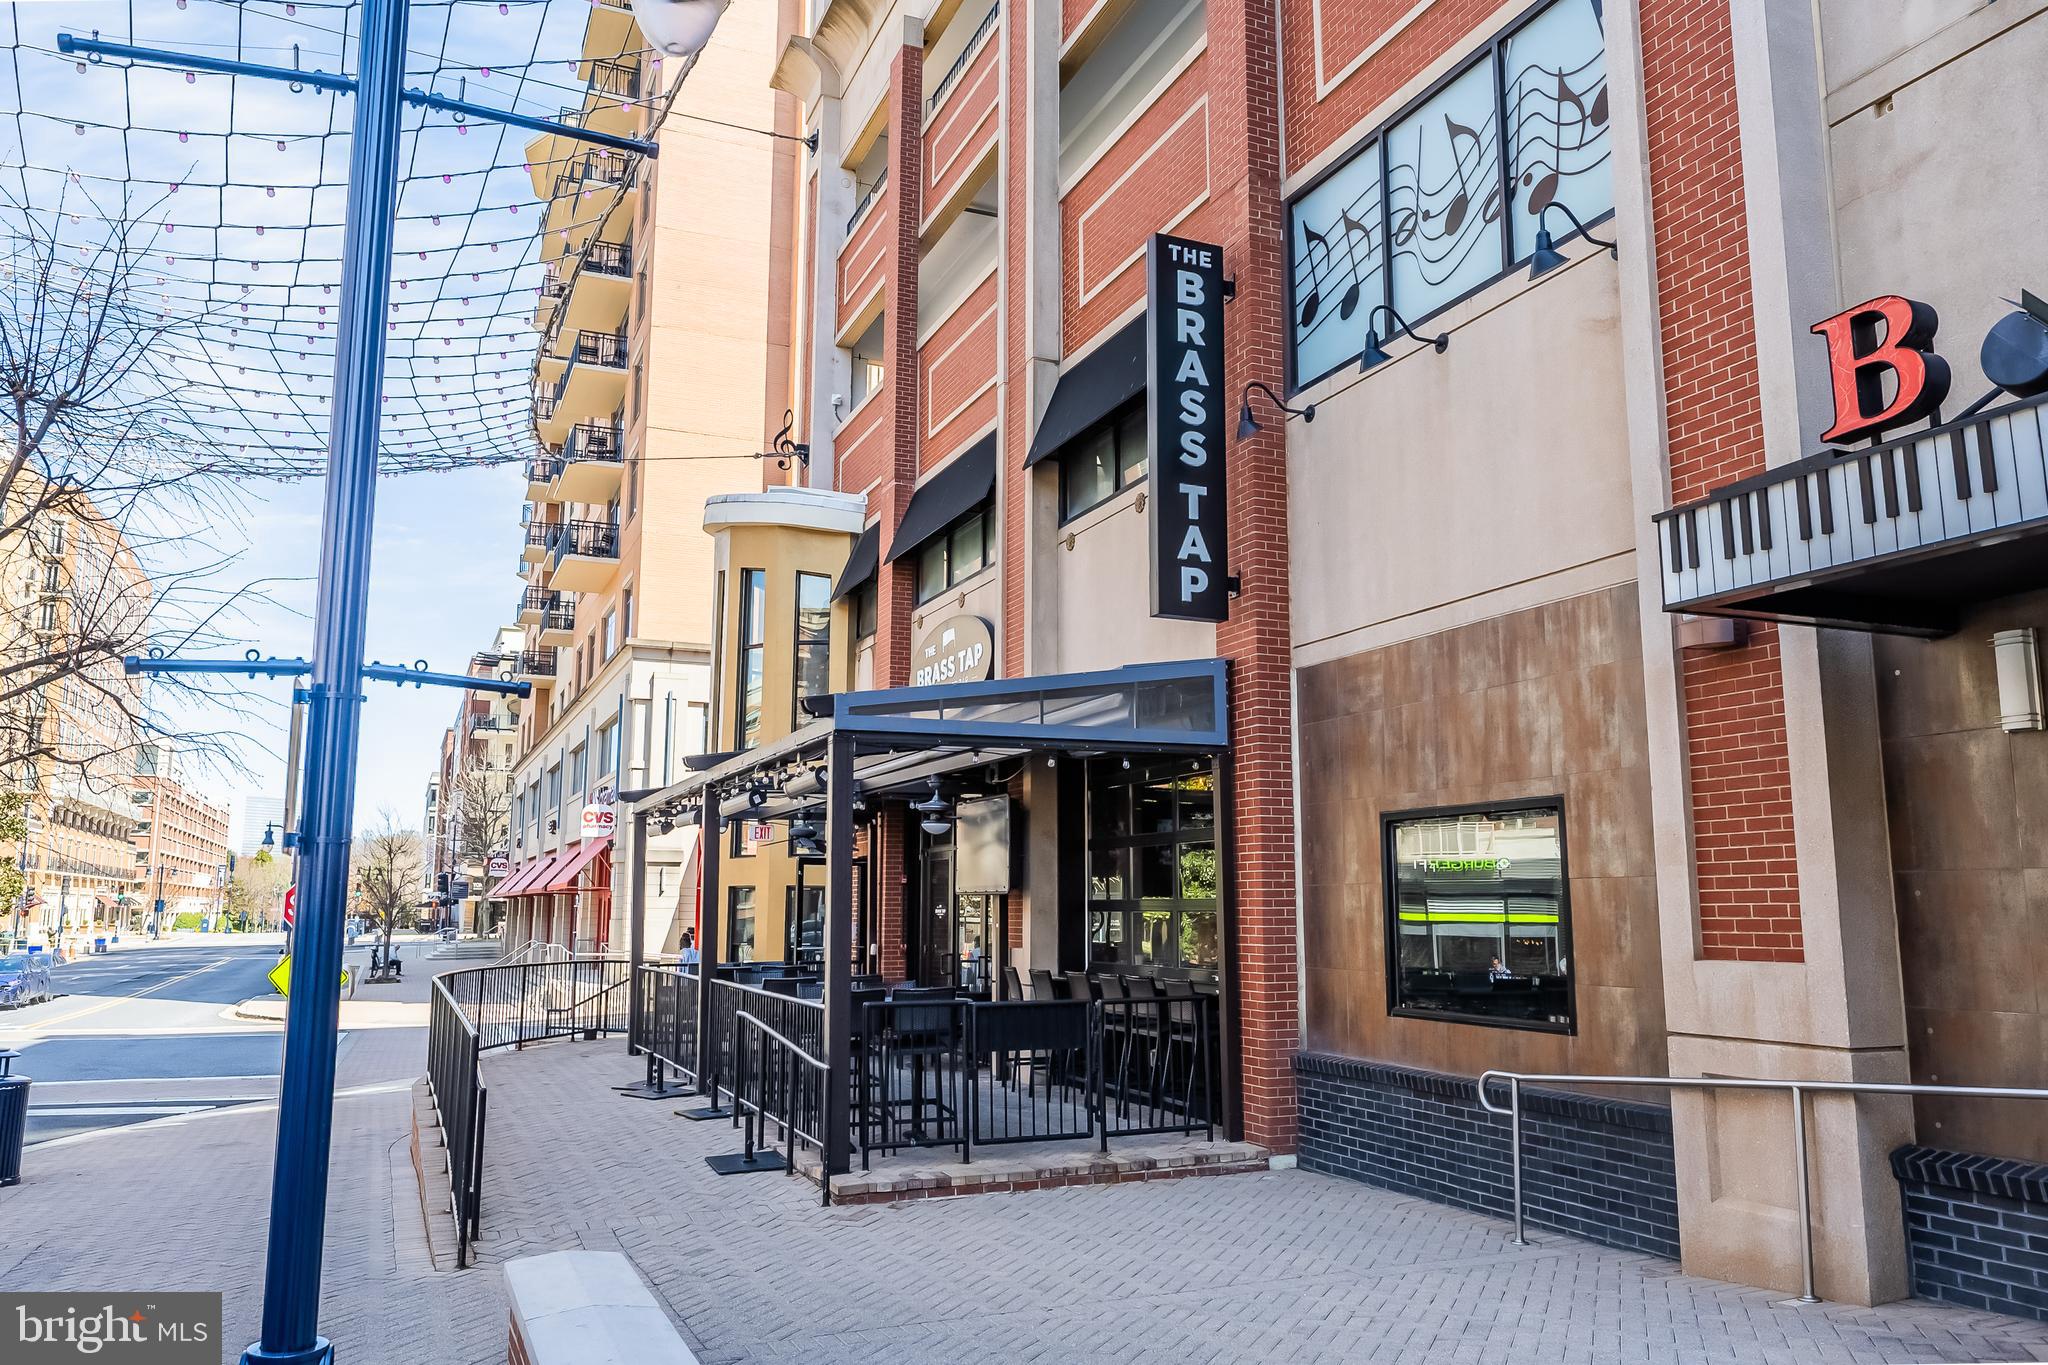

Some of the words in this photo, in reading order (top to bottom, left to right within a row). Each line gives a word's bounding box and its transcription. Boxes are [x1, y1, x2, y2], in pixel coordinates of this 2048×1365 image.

[1168, 243, 1212, 269] THE
[1174, 269, 1209, 468] BRASS
[1177, 482, 1212, 602] TAP
[917, 656, 955, 687] BRASS
[958, 643, 982, 673] TAP
[925, 645, 937, 659] THE
[583, 811, 614, 824] CVS
[754, 826, 771, 840] EXIT
